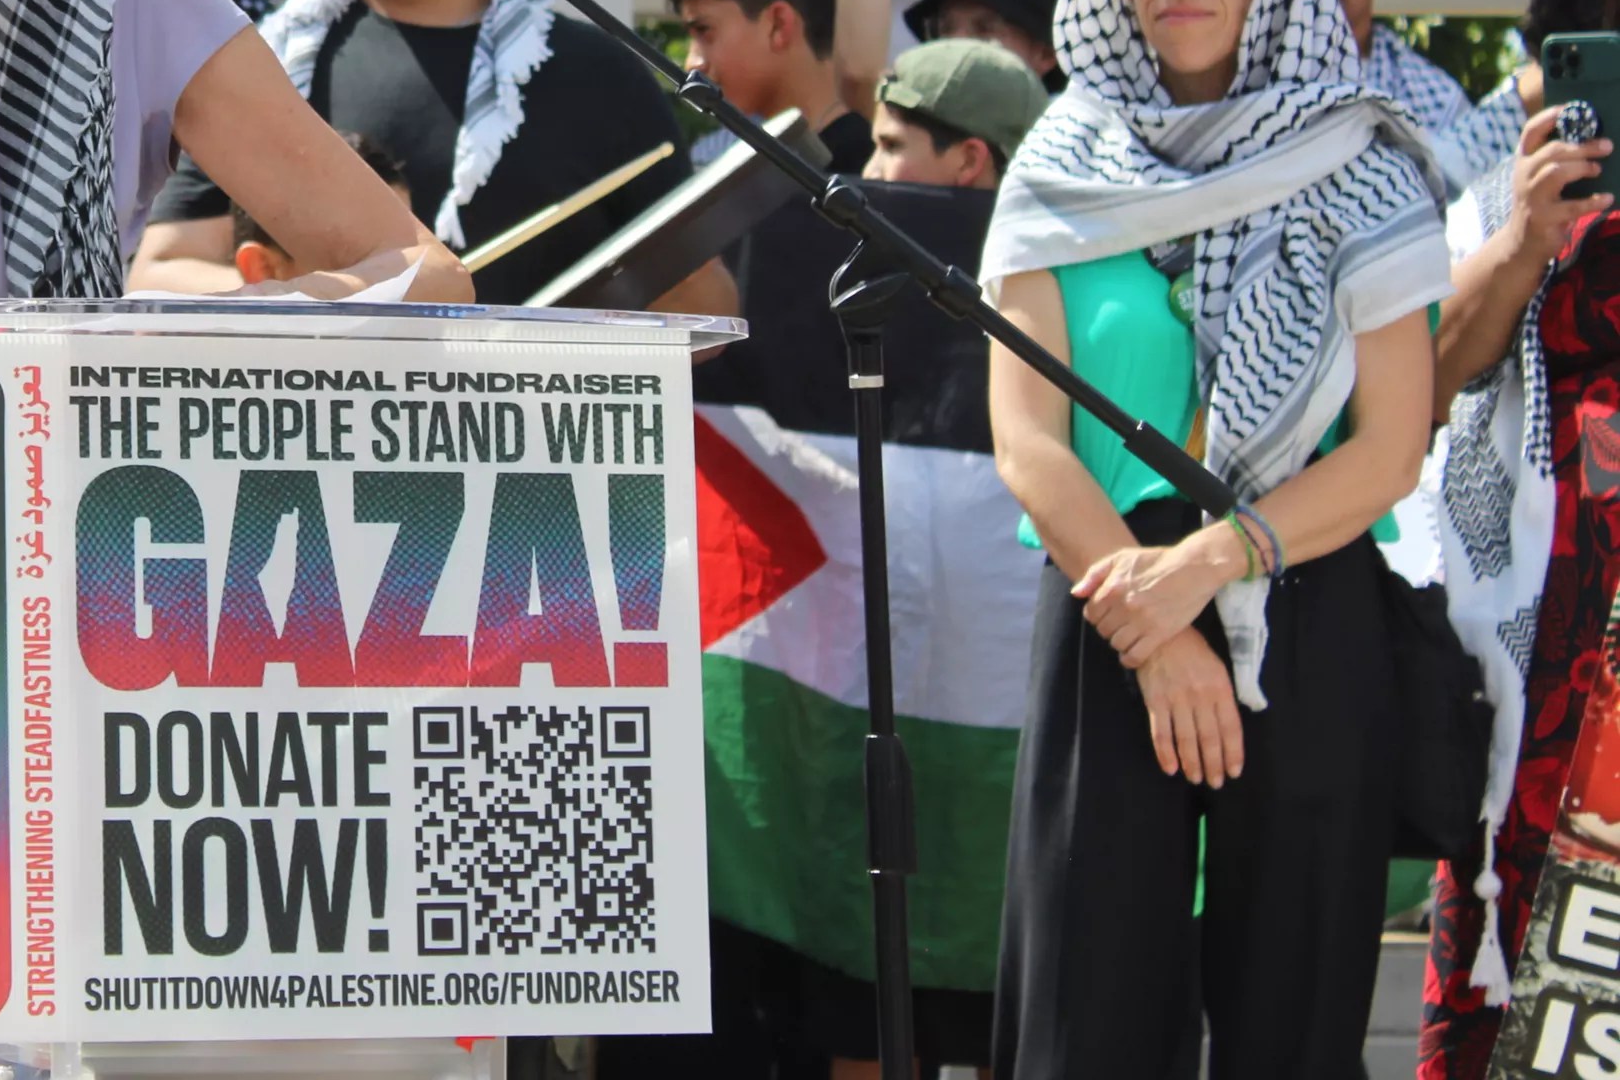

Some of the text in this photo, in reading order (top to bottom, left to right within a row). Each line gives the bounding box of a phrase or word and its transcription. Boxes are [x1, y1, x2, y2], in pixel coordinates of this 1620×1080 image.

[69, 365, 663, 396] INTERNATIONAL FUNDRAISER
[69, 395, 664, 465] THE PEOPLE STAND WITH
[16, 531, 53, 579] غزة
[75, 464, 669, 692] GAZA!
[103, 709, 391, 809] DONATE
[22, 595, 56, 1017] STRENGTHENING STEADFASTNESS
[101, 816, 390, 958] NOW!
[84, 970, 681, 1013] SHUTITDOWN4PALESTINE.ORG/FUNDRAISER
